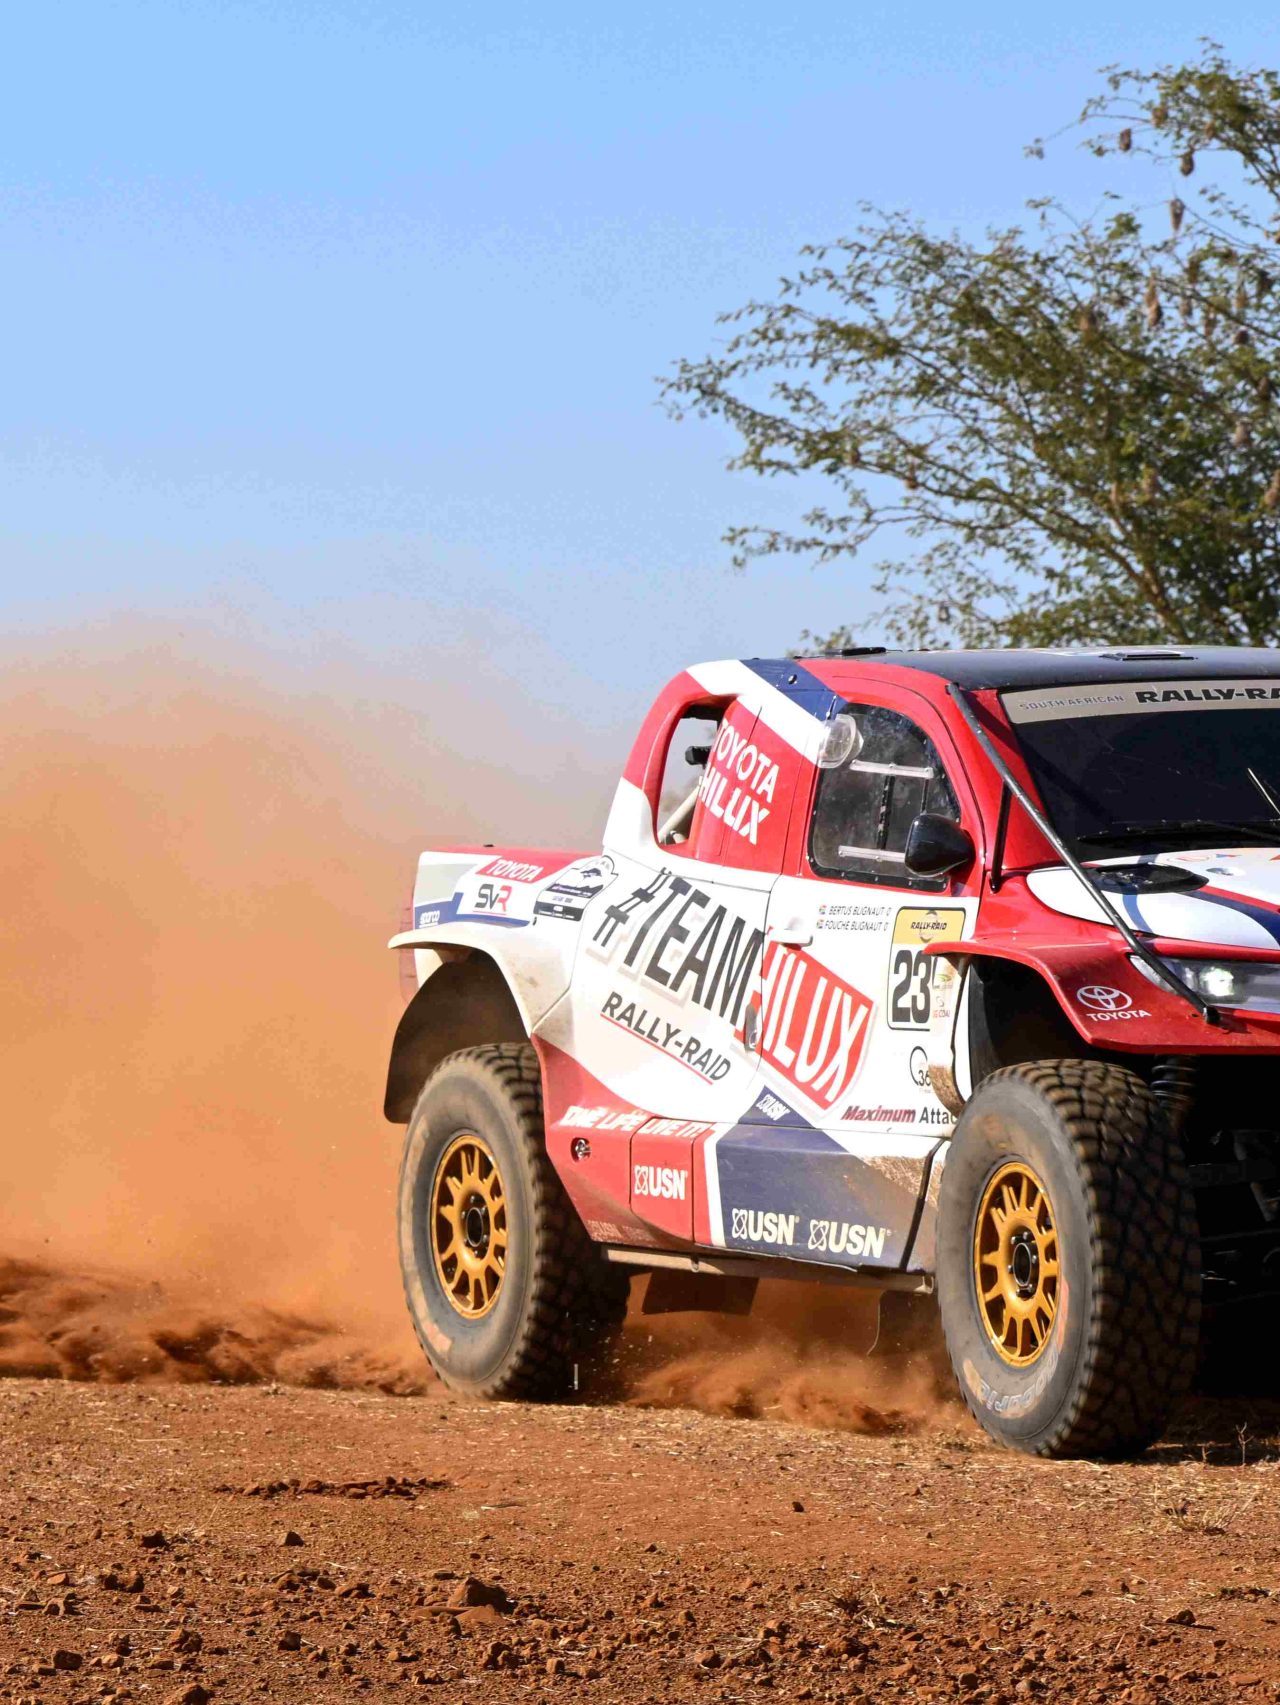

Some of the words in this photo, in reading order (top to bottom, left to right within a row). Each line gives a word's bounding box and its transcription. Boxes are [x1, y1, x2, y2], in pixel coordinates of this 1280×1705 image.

[1019, 699, 1065, 711] SOUTH
[1068, 694, 1125, 706] AFRICAN
[713, 718, 780, 804] TOYOTA
[698, 762, 770, 846] HILUX
[487, 859, 545, 882] TOYOTA
[474, 883, 513, 912] SVR
[910, 921, 948, 931] RALLY-RAID
[892, 950, 932, 1024] 23
[1086, 1009, 1152, 1022] TOYOTA
[602, 991, 732, 1082] RALLY-RAID
[559, 1106, 609, 1128] ONE
[841, 1105, 917, 1123] Maximum
[918, 1106, 960, 1125] Attac
[649, 1166, 688, 1200] USN
[748, 1209, 796, 1246] USN
[828, 1220, 886, 1259] USN
